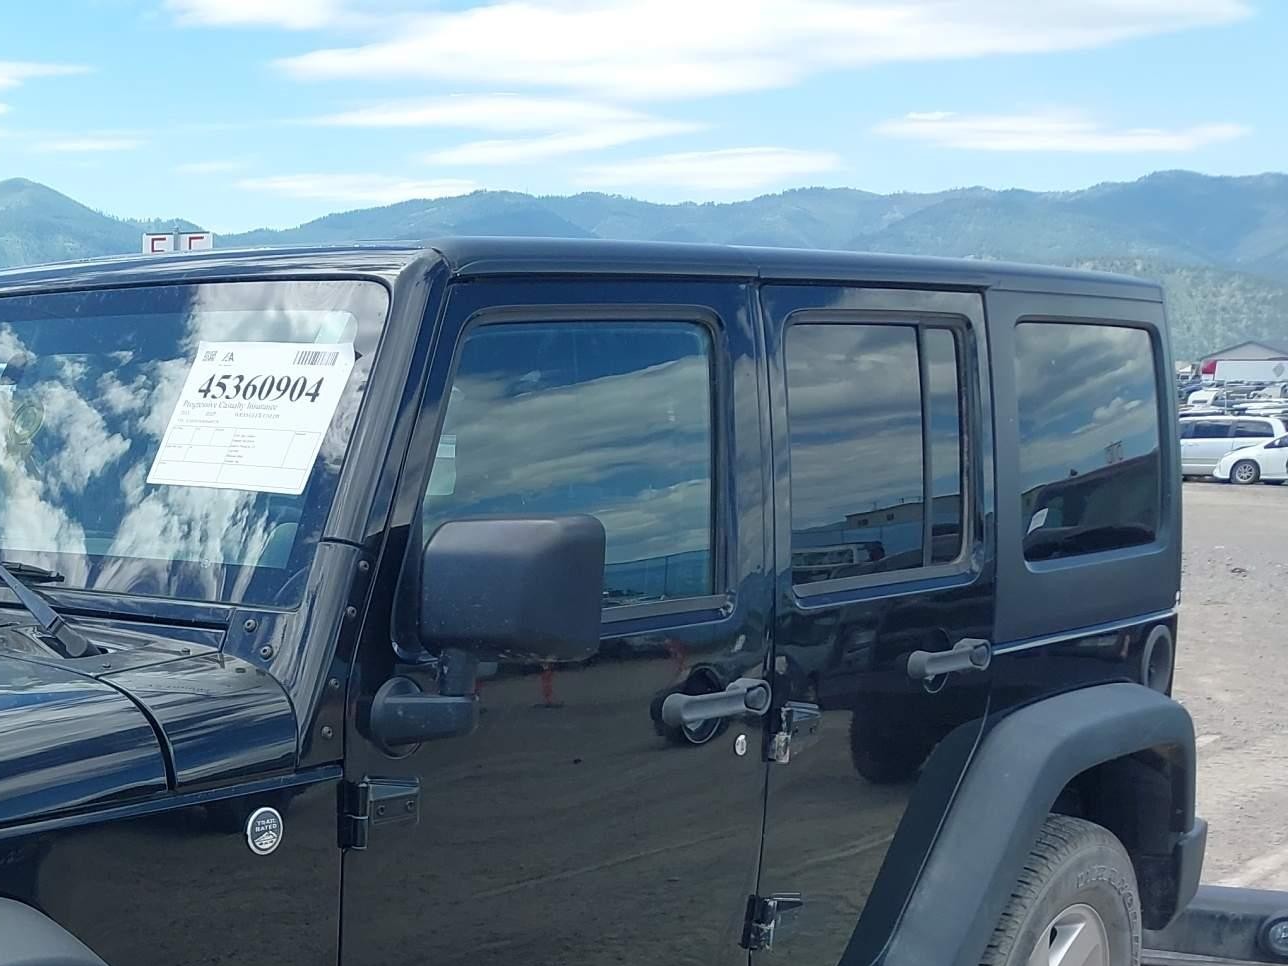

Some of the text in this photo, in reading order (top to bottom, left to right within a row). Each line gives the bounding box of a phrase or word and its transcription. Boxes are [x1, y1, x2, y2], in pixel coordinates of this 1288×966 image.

[198, 374, 324, 402] 45360904
[256, 818, 277, 826] TRAIL
[255, 824, 277, 832] RATED
